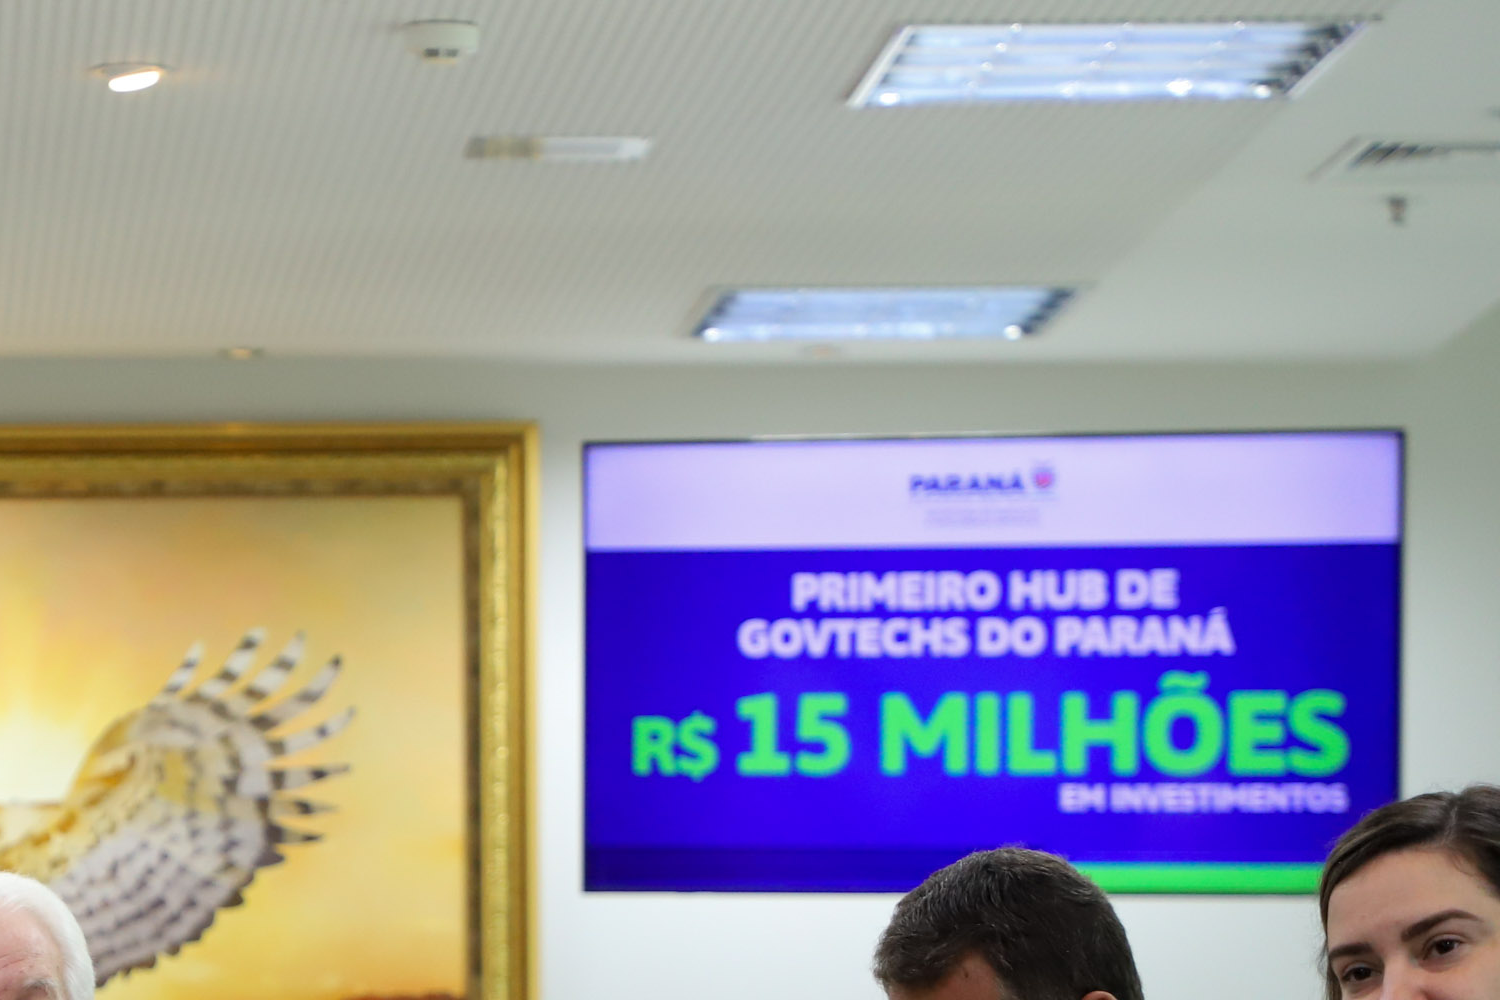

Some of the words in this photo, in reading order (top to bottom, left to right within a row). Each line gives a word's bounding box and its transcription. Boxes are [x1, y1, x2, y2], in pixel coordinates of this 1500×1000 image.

[791, 570, 1002, 612] PRIMEIRO
[1008, 569, 1108, 611] HUB
[1114, 568, 1180, 610] DE
[736, 617, 971, 659] GOVTECHS
[975, 616, 1047, 658] DO
[1054, 606, 1237, 656] PARANÁ
[631, 711, 719, 782] R$
[736, 692, 850, 777] 15
[879, 670, 1350, 777] MILHÕES
[1058, 782, 1106, 813] EM
[1111, 782, 1349, 813] INVESTIMENTOS
